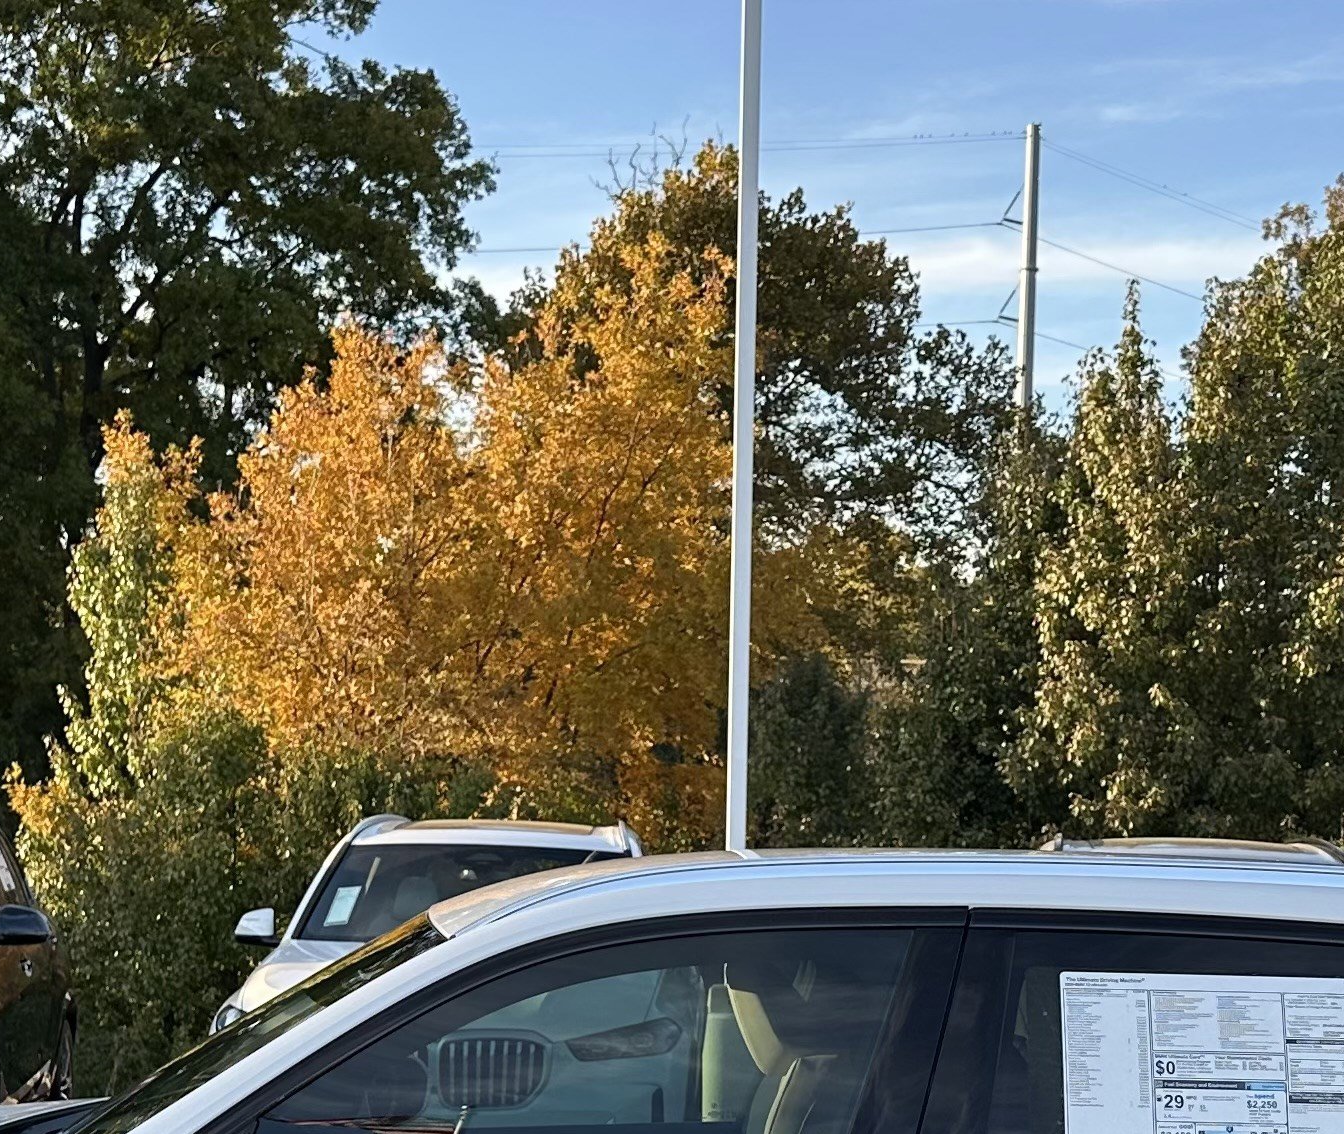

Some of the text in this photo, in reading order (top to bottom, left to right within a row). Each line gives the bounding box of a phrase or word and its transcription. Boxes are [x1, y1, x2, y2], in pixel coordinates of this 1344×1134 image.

[1155, 1060, 1176, 1076] $0
[1163, 1094, 1184, 1109] 29
[1246, 1099, 1278, 1110] $2,250
